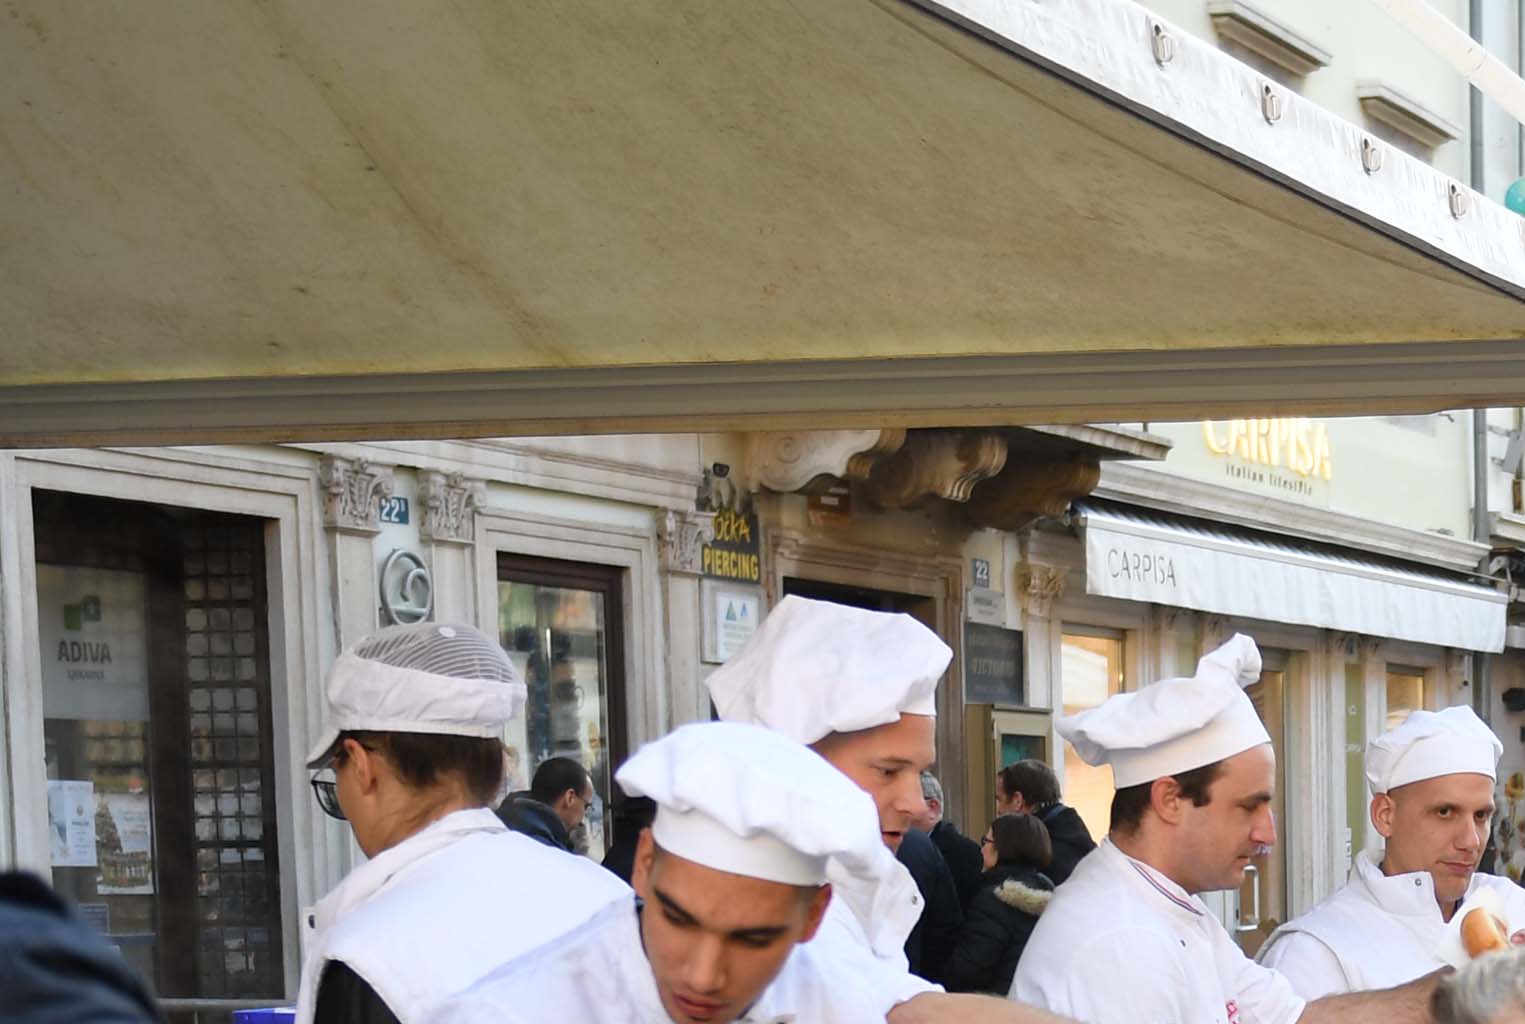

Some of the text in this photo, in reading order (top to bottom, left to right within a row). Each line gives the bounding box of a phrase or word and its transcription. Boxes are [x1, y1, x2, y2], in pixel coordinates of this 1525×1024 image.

[1204, 419, 1332, 482] CARPISA
[703, 546, 759, 581] PIERCING
[1107, 548, 1177, 588] CARPISA
[57, 640, 112, 664] ADIVA
